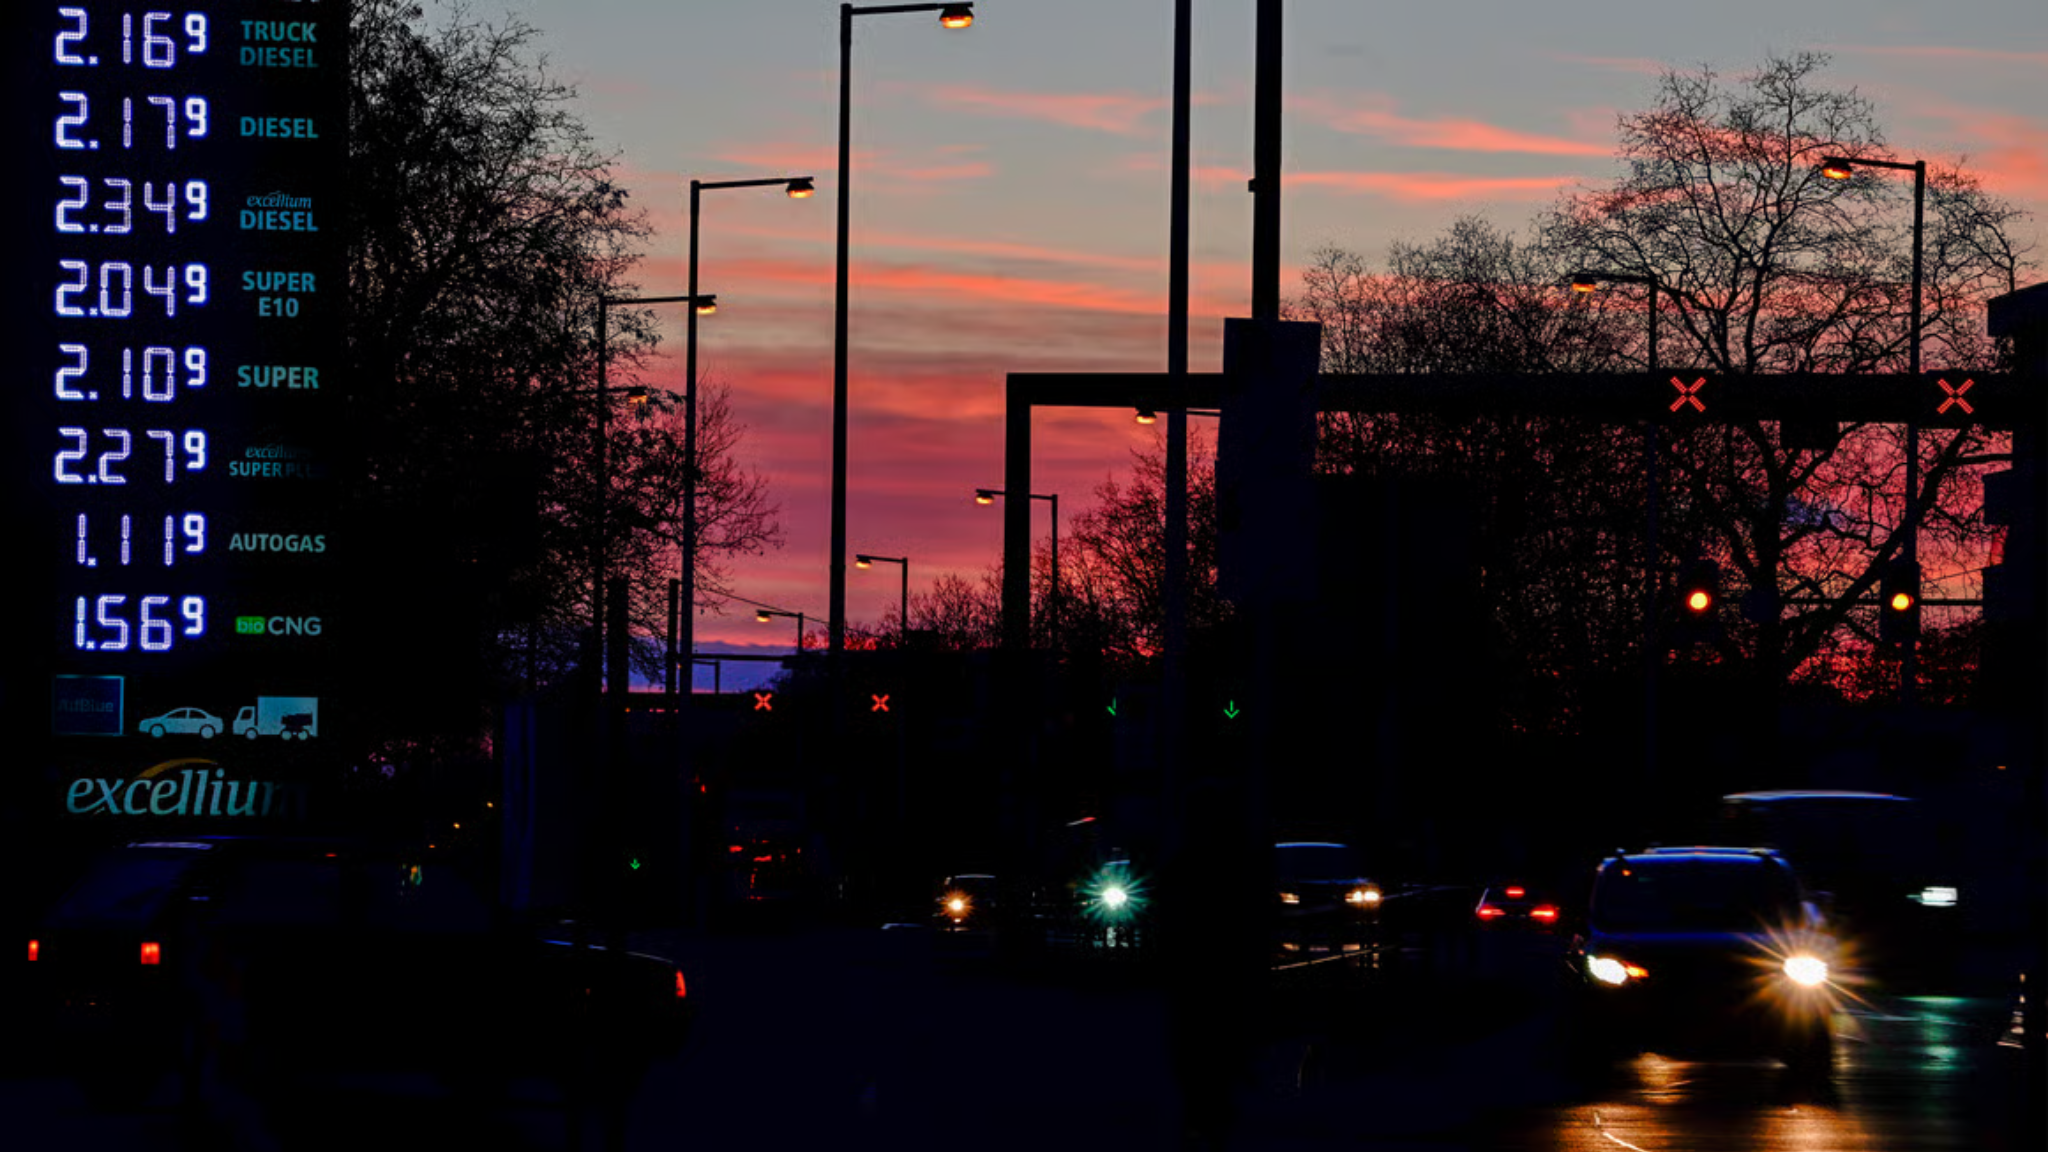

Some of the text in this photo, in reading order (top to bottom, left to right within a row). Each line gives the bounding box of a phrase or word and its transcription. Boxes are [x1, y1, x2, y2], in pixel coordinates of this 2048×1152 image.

[240, 20, 318, 43] TRUCK
[240, 46, 319, 68] DIESEL
[240, 116, 319, 139] DIESEL
[240, 210, 319, 232] DIESEL
[242, 271, 316, 293] SUPER
[258, 297, 300, 318] E10
[237, 365, 320, 390] SUPER
[228, 461, 283, 478] SUPER
[229, 533, 327, 553] AUTOGAS
